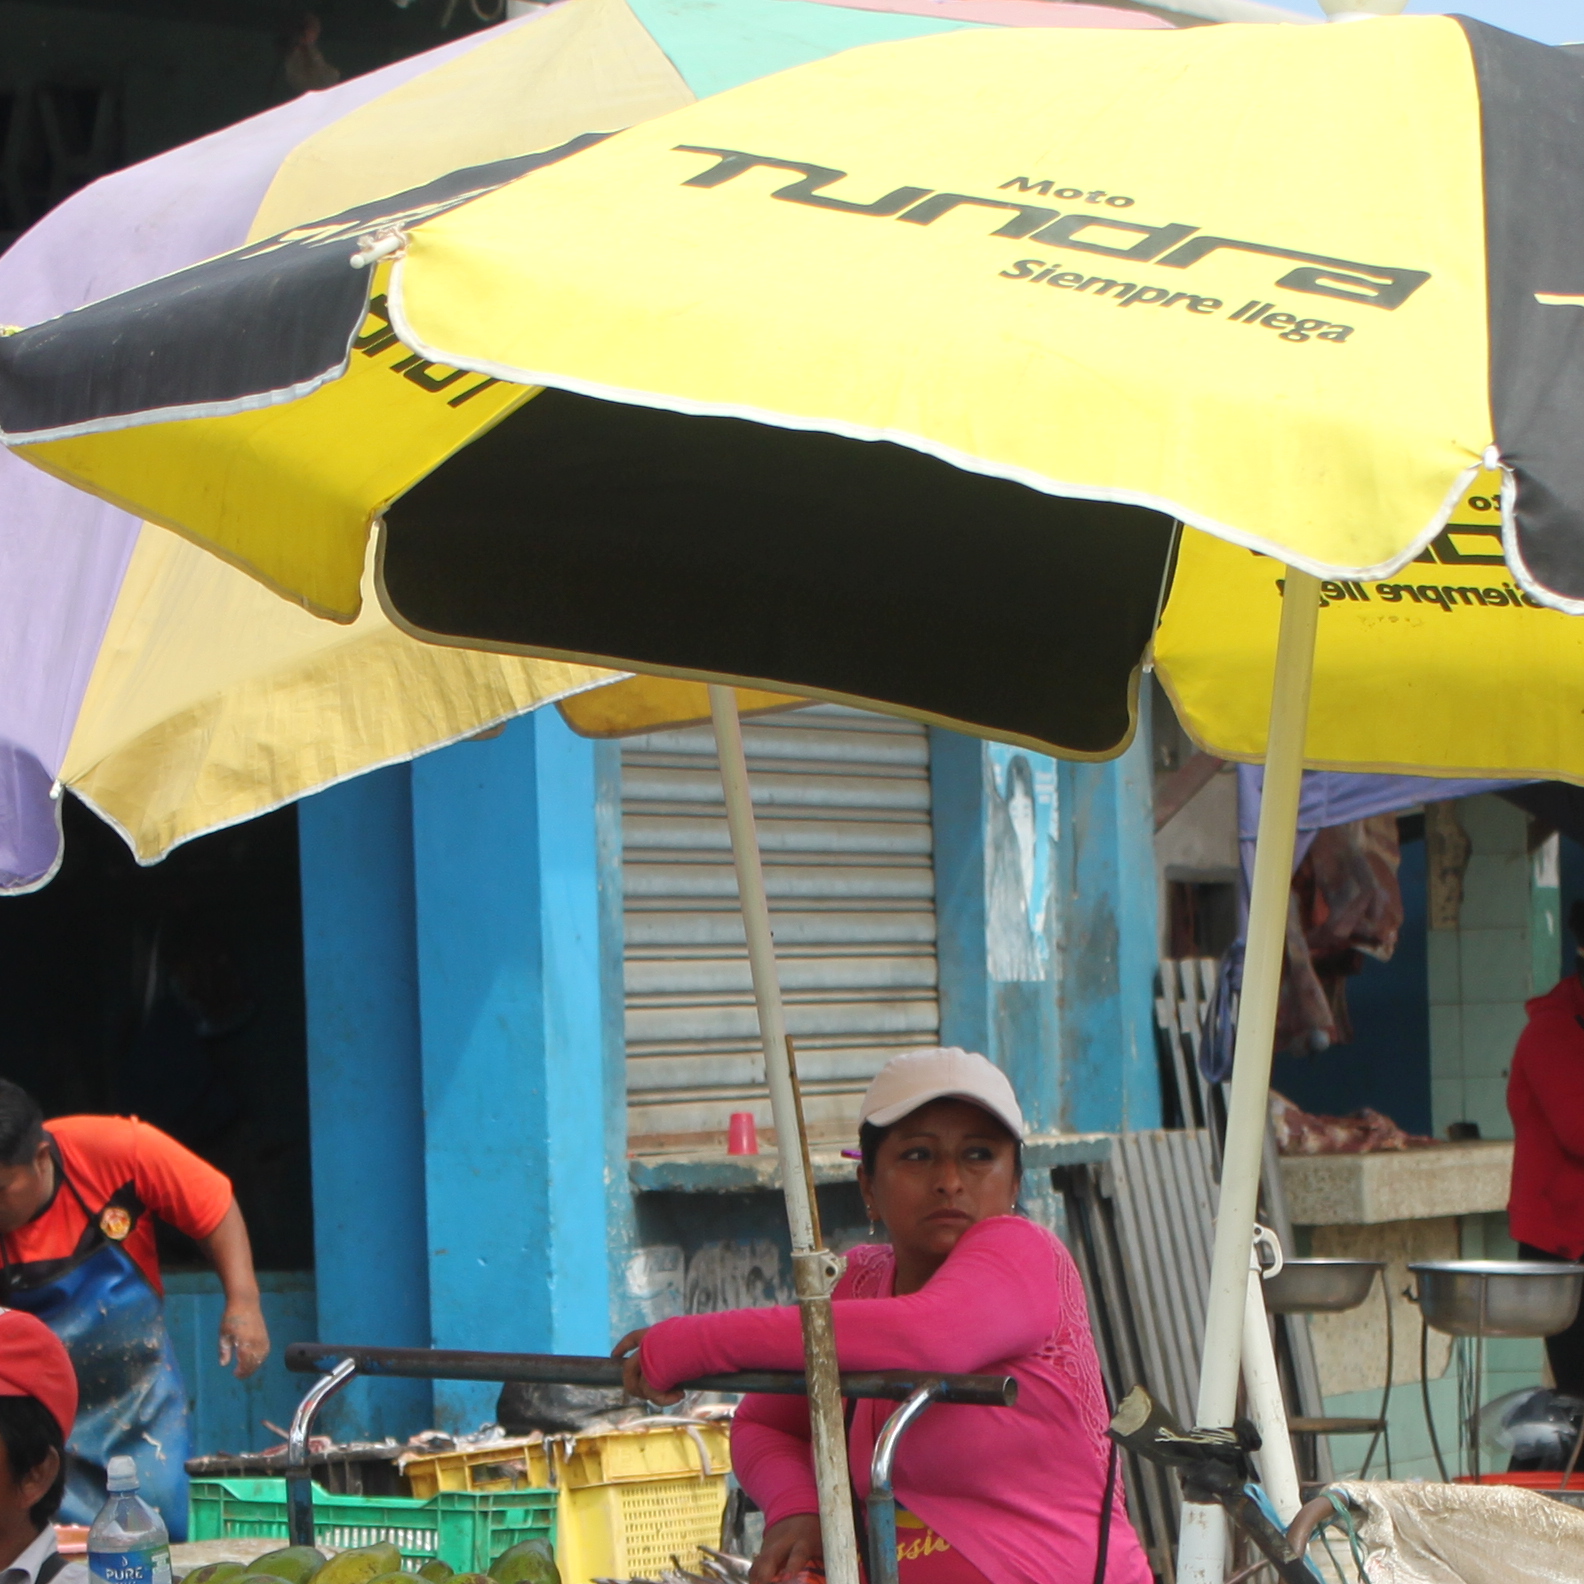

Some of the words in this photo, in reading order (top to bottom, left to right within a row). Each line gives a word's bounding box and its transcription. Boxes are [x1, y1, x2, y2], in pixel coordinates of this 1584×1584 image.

[997, 175, 1136, 209] Moto
[998, 258, 1224, 316] Siempre
[1226, 299, 1356, 345] llega
[105, 1565, 144, 1580] PURE
